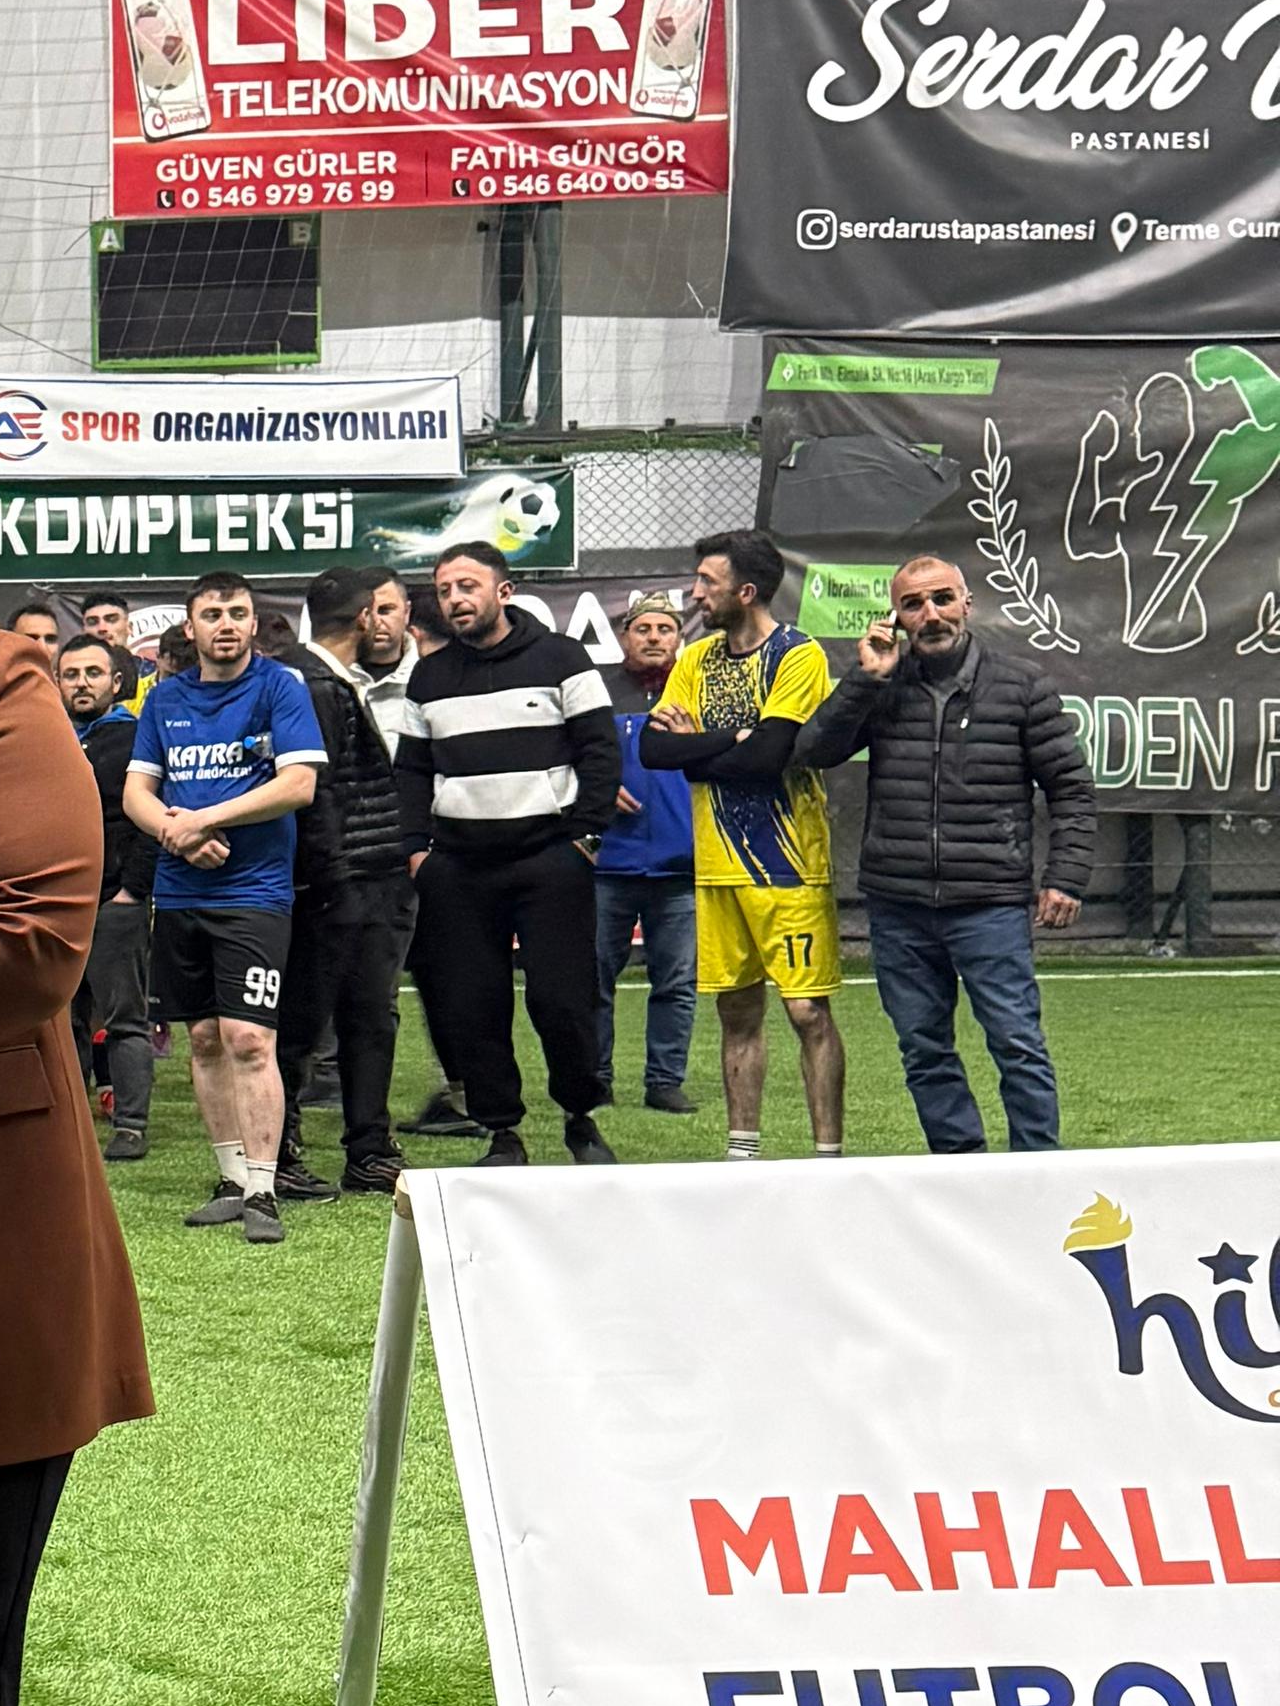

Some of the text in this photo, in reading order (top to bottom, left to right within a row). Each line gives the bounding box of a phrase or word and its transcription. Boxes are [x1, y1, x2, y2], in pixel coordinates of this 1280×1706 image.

[213, 65, 628, 119] TELEKOMÜNİKASYON
[451, 136, 685, 170] FATİH GÜNGÖR
[1071, 129, 1209, 151] PASTANESİ
[156, 147, 397, 183] GÜVEN GÜRLER
[181, 180, 394, 209] 0 546 979 76 99
[477, 169, 685, 198] 0 546 640 00 55
[840, 218, 1095, 245] serdarustapastanesi
[1143, 220, 1220, 241] Terme
[61, 412, 140, 442] SPOR
[152, 406, 448, 443] ORGANİZASYONLARI
[168, 741, 244, 768] KAYRA
[783, 932, 814, 968] 17
[243, 966, 281, 1009] 99
[1065, 1231, 1280, 1424] hi
[689, 1485, 1280, 1595] MAHALL
